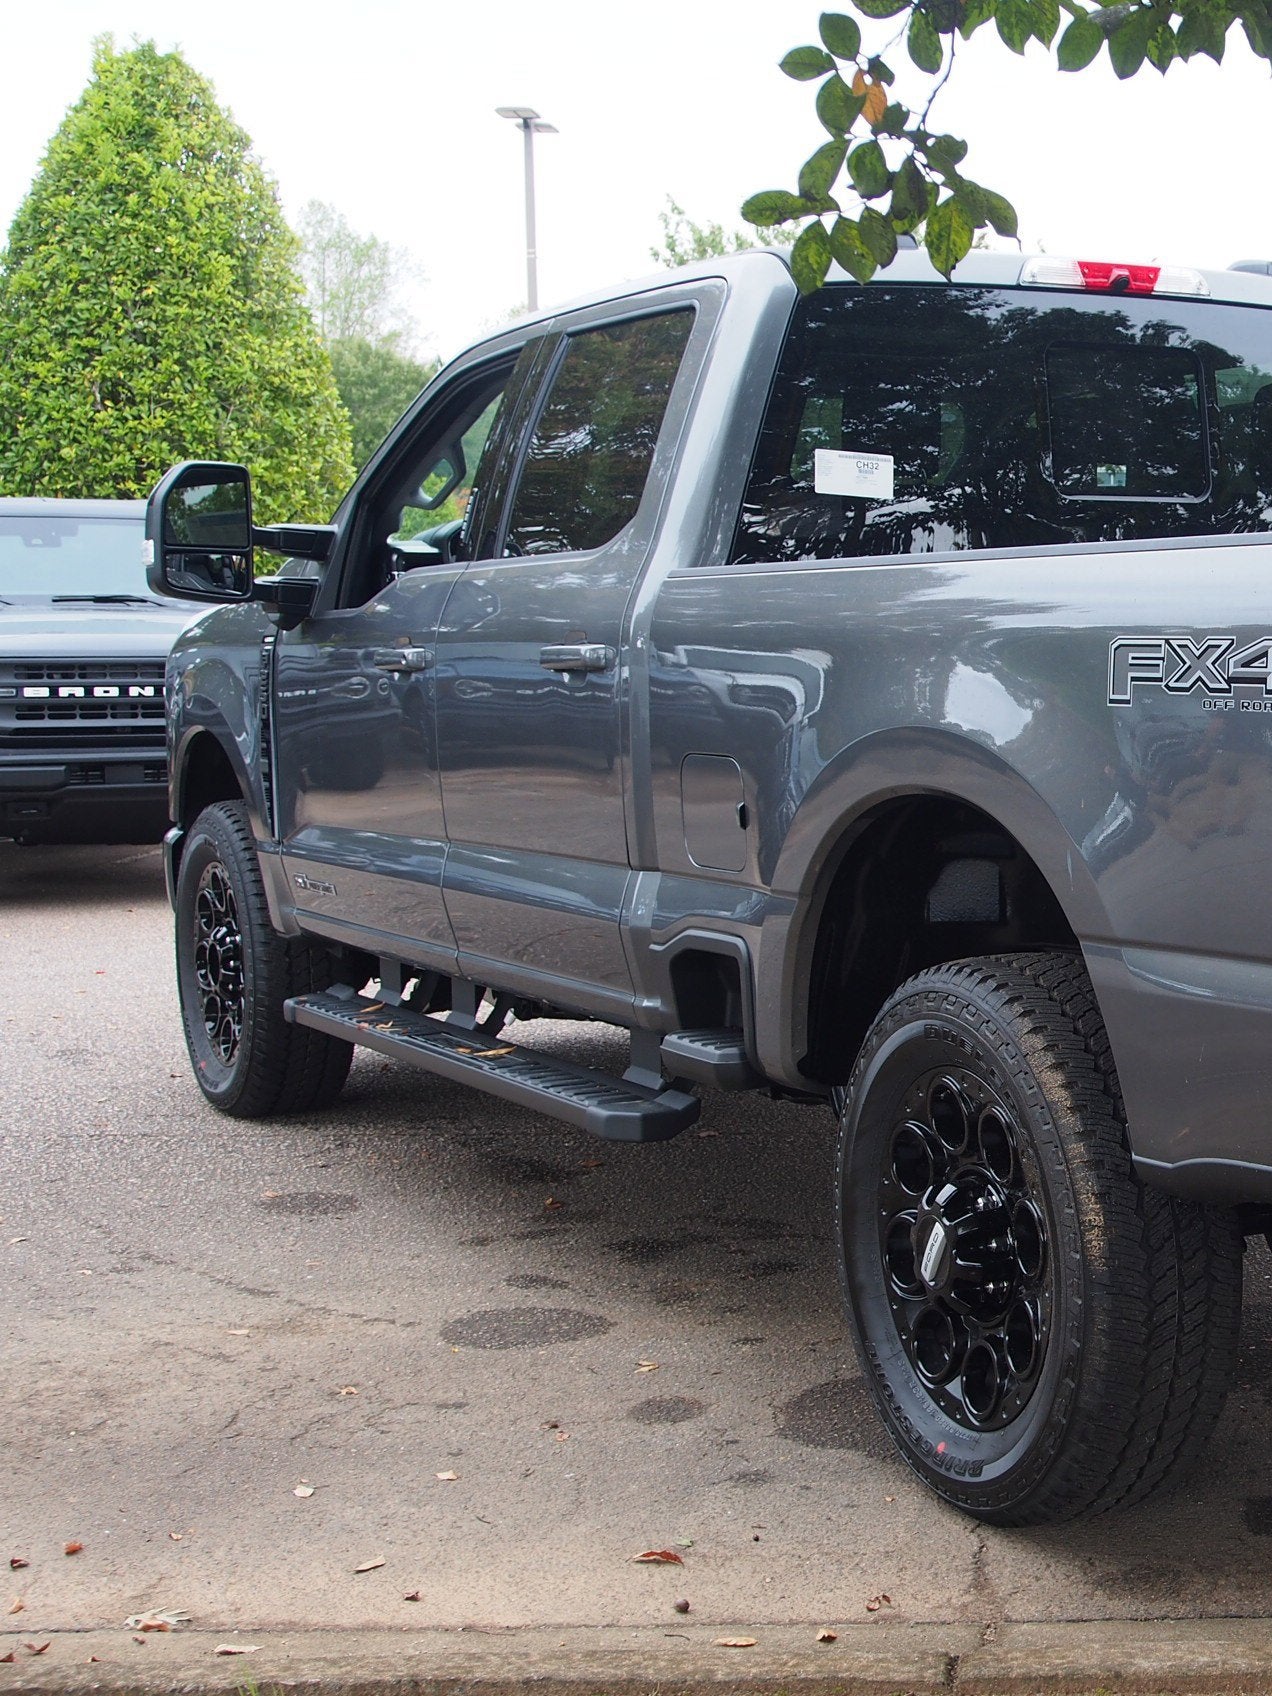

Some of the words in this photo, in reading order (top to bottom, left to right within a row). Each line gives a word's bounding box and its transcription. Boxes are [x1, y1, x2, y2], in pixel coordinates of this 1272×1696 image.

[856, 461, 880, 471] CH32
[23, 686, 166, 697] BRON
[1202, 699, 1235, 710] OFF
